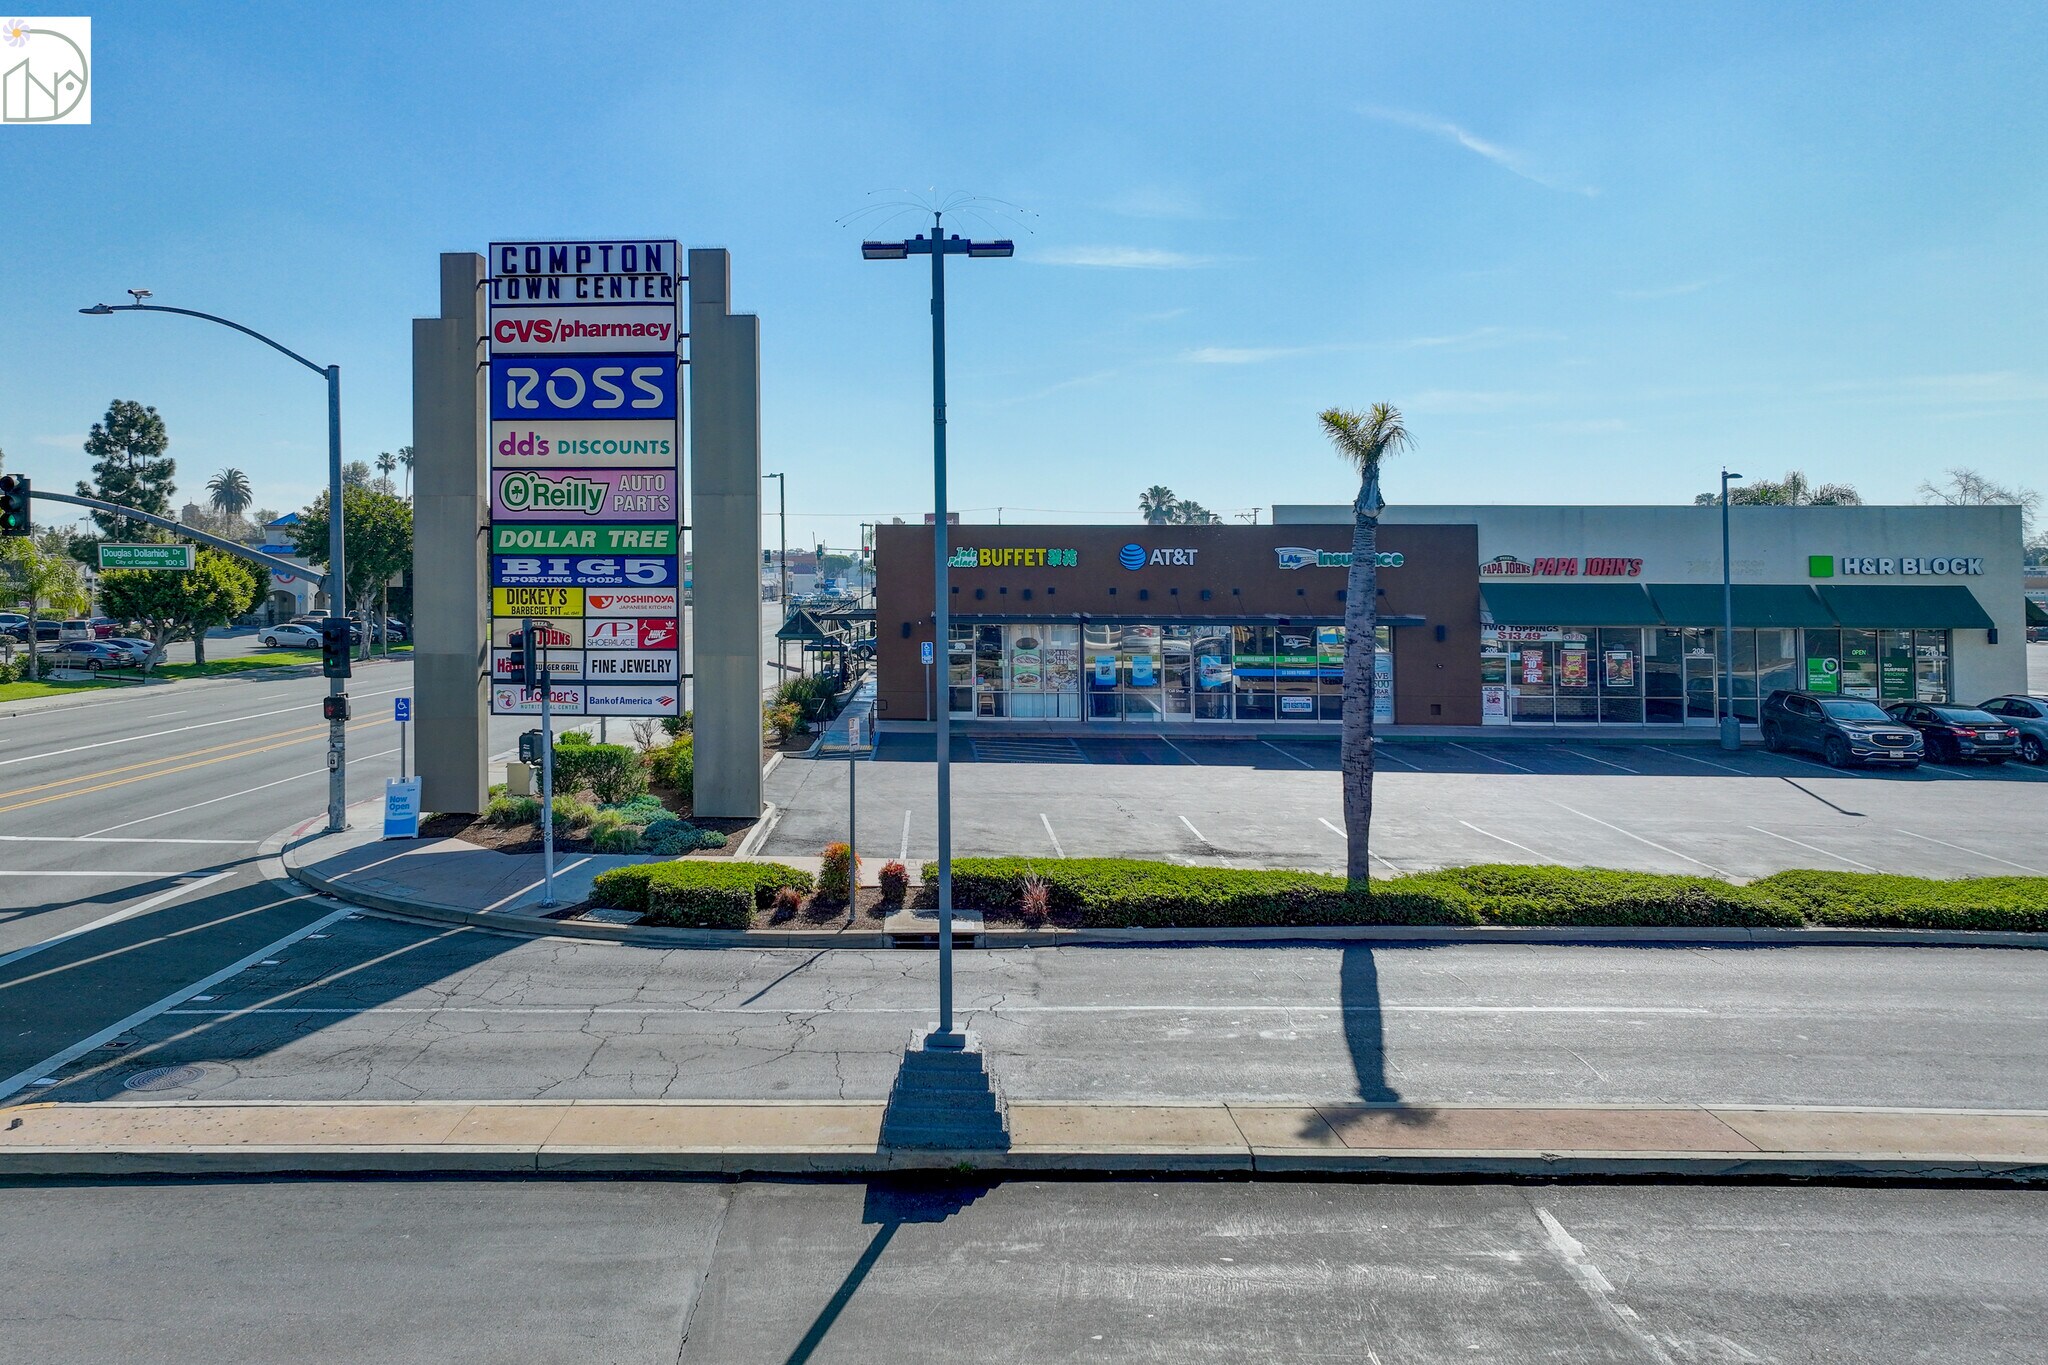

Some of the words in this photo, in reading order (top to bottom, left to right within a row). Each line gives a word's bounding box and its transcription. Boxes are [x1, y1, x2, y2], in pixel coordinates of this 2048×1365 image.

[501, 244, 662, 274] COMPTON
[492, 277, 561, 299] TOWN
[576, 275, 673, 299] CENTER
[494, 319, 672, 344] CVS/pharmacy
[507, 367, 664, 409] ROSS
[498, 431, 550, 456] dd's
[558, 439, 671, 455] DISCOUNTS
[504, 475, 603, 513] O'Reilly
[618, 474, 665, 492] AUTO
[613, 494, 670, 512] PARTS
[498, 530, 597, 548] DOLLAR
[607, 529, 669, 548] TREE
[103, 548, 132, 559] Douglas
[134, 548, 169, 558] Dollarhide
[979, 547, 1047, 567] BUFFET
[1149, 548, 1198, 566] AT&T
[1317, 550, 1405, 567] Insunce
[501, 558, 621, 575] BIG
[624, 559, 668, 584] 5
[1482, 562, 1504, 574] PAPA
[1532, 557, 1579, 577] PAPA
[1583, 557, 1644, 577] JOHN'S
[1842, 557, 1895, 576] H&R
[1901, 557, 1985, 576] BLOCK
[577, 576, 623, 584] GOODS
[506, 588, 568, 605] DICKEY'S
[511, 606, 548, 615] BARBECUE
[550, 606, 561, 615] PIT
[648, 629, 667, 639] NIKE
[1482, 624, 1506, 632] TWO
[561, 663, 579, 671] GRILL
[592, 659, 617, 674] FINE
[620, 659, 672, 674] JEWELRY
[589, 696, 612, 705] Bank
[612, 696, 619, 705] of
[620, 696, 653, 705] America
[388, 803, 410, 812] Open
[389, 795, 408, 804] Now
